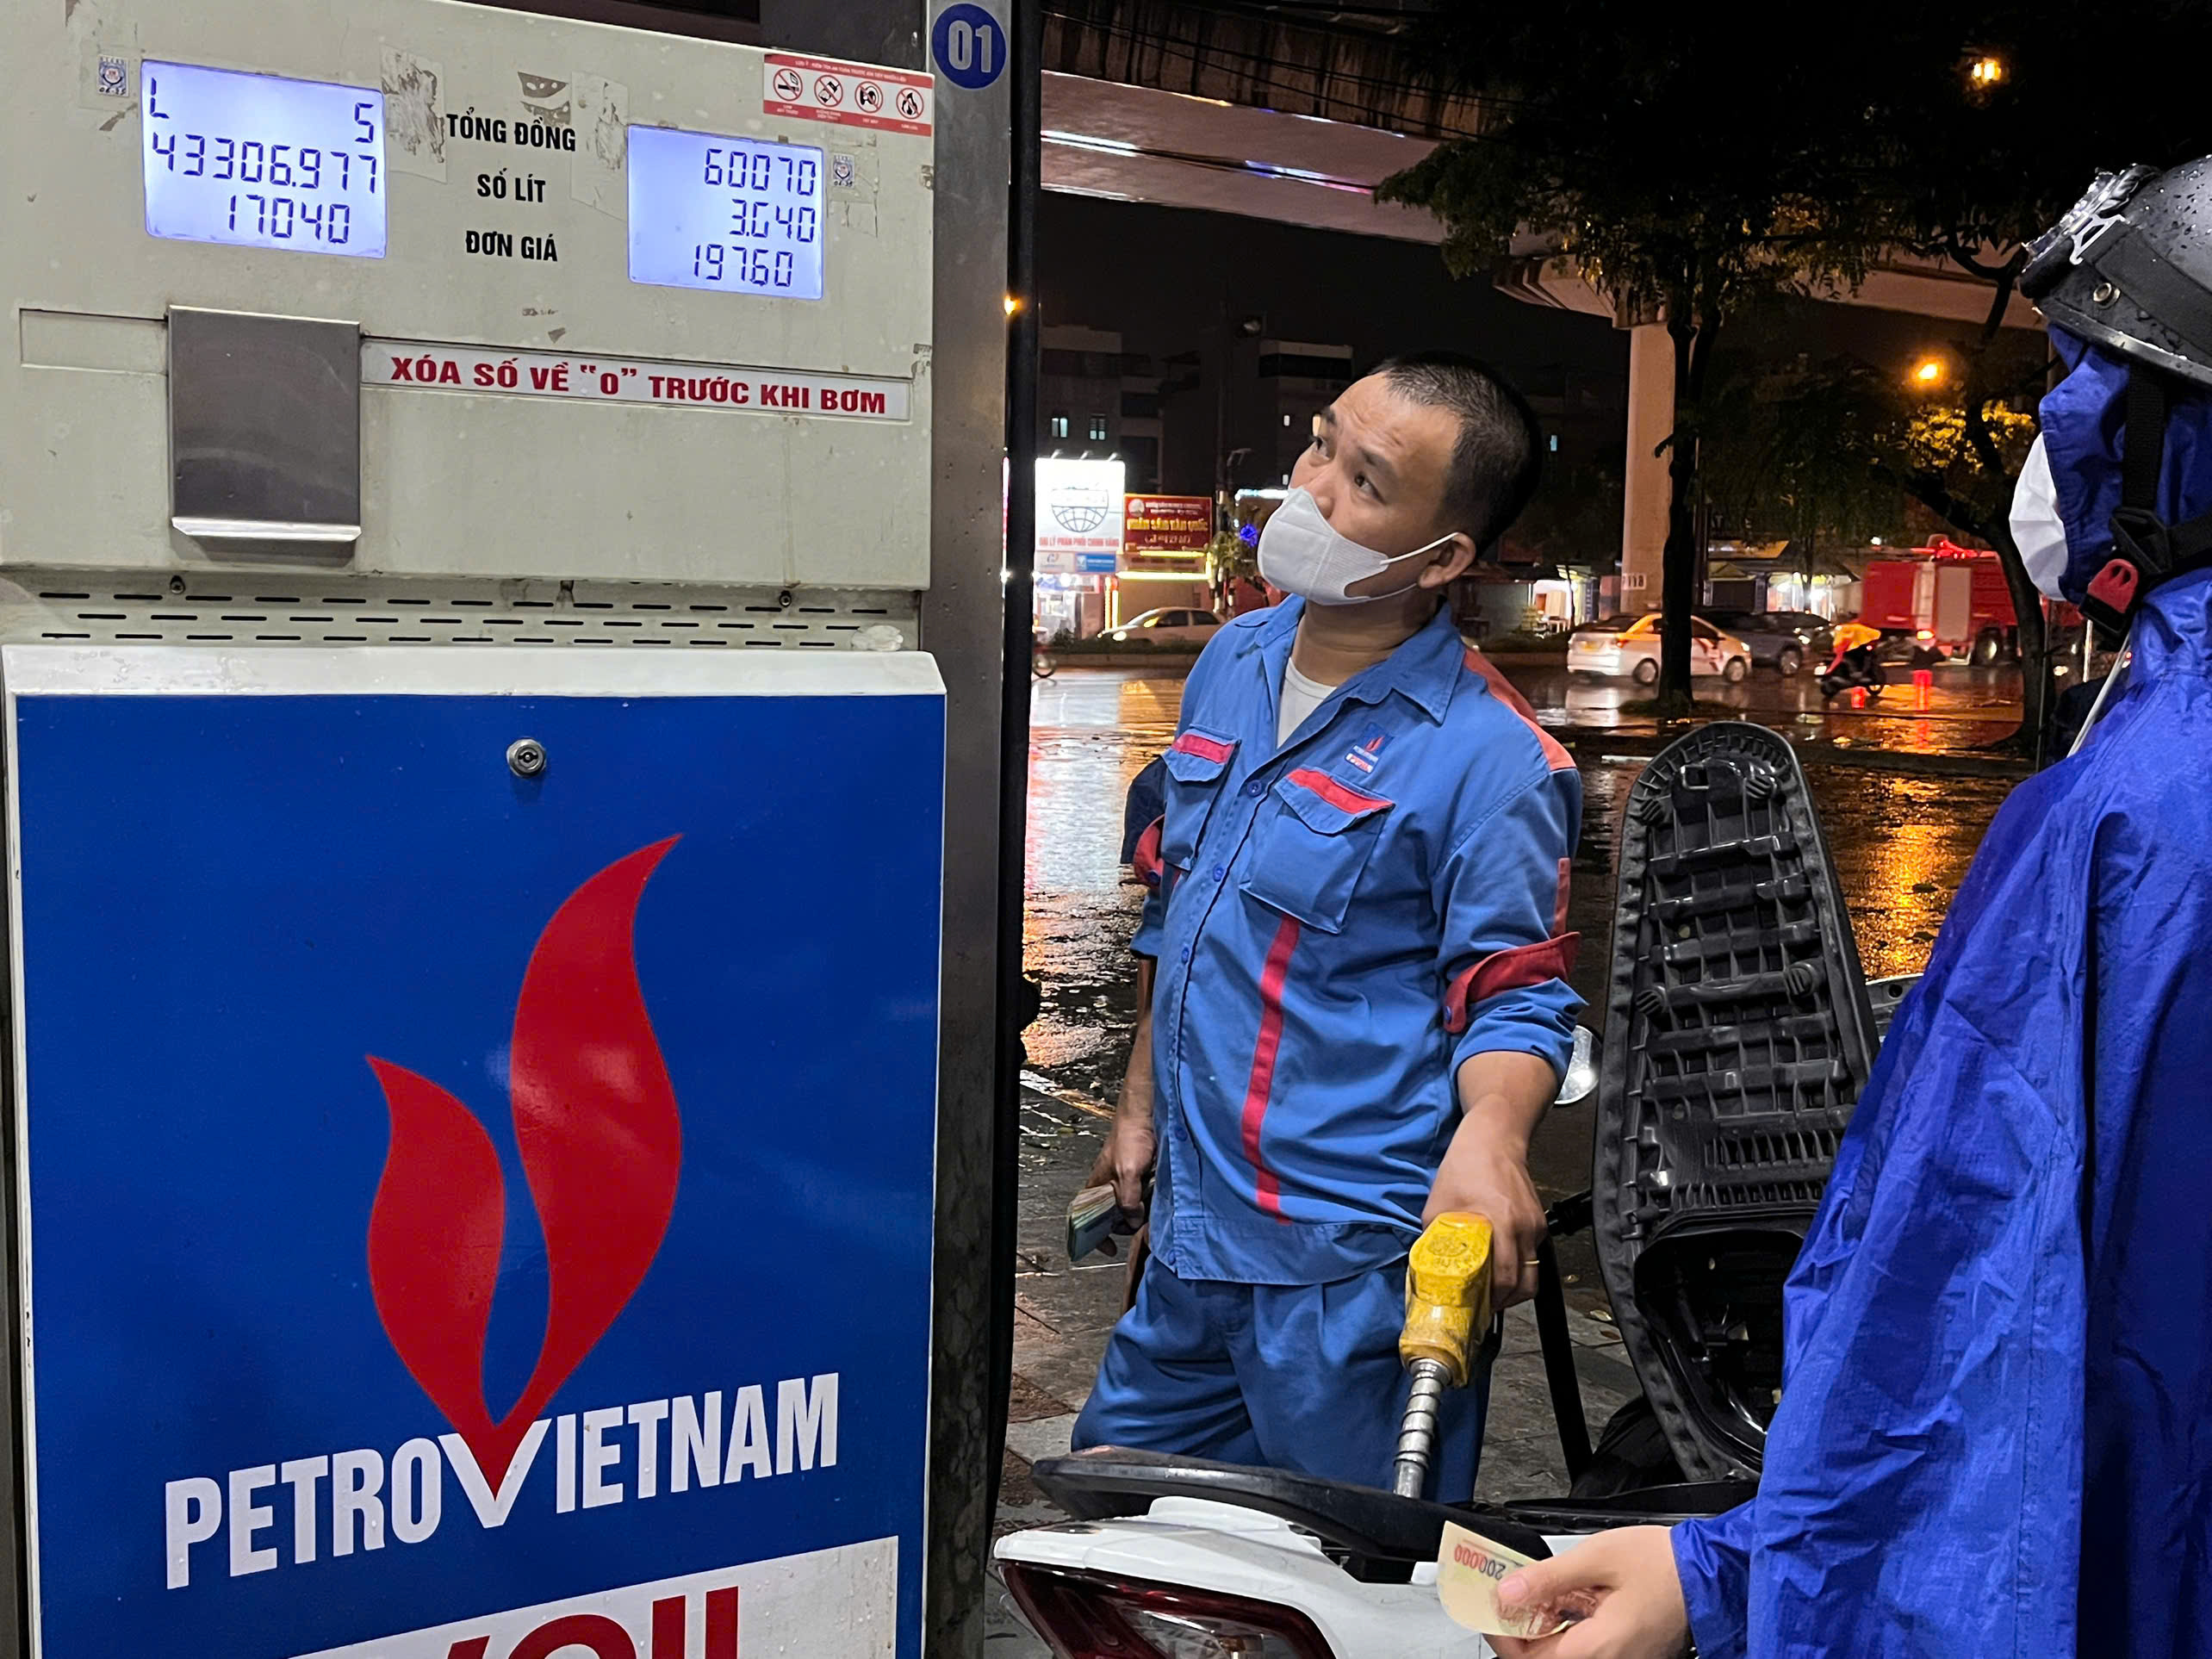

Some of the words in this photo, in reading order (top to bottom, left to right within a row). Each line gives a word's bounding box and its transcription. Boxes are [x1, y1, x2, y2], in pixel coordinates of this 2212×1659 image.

[948, 20, 992, 73] 01
[446, 107, 506, 143] TỔNG
[514, 117, 576, 152] ĐỒNG
[152, 132, 377, 194] 43306.977
[477, 168, 507, 199] SỐ
[515, 173, 546, 203] LÍT
[704, 148, 816, 196] 60070
[228, 194, 350, 244] 17040
[466, 230, 513, 257] ĐƠN
[521, 233, 558, 262] GIÁ
[693, 244, 793, 287] 19760
[391, 354, 462, 384] XÓA
[474, 357, 519, 388] SỐ
[530, 362, 569, 392] VỀ
[649, 376, 749, 404] TRƯỚC
[761, 384, 810, 408] KHI
[820, 388, 885, 414] BƠM
[165, 1373, 839, 1589] PETROVIETNAM
